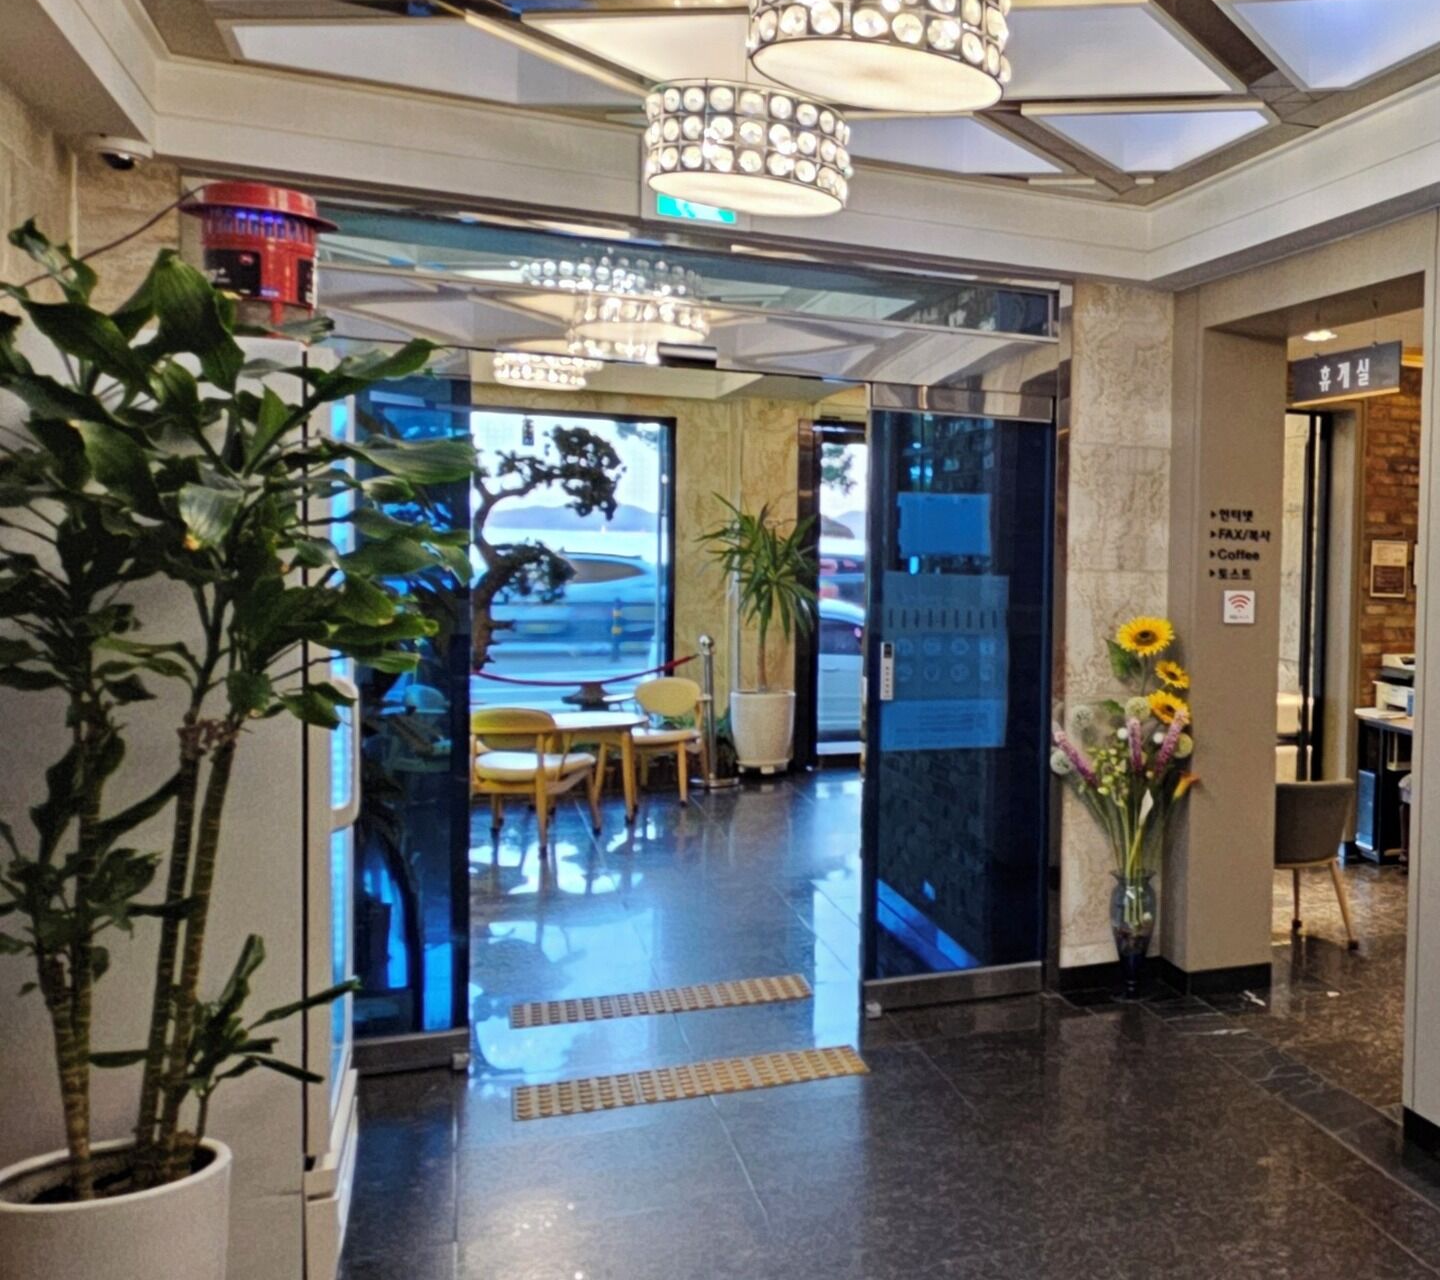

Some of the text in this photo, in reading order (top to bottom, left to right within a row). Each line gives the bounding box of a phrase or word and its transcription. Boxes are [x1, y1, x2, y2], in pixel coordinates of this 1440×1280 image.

[1318, 358, 1371, 393] 휴게실
[1218, 508, 1254, 523] 인터넷
[1217, 548, 1260, 561] Coffee
[1218, 567, 1252, 581] 토스트
